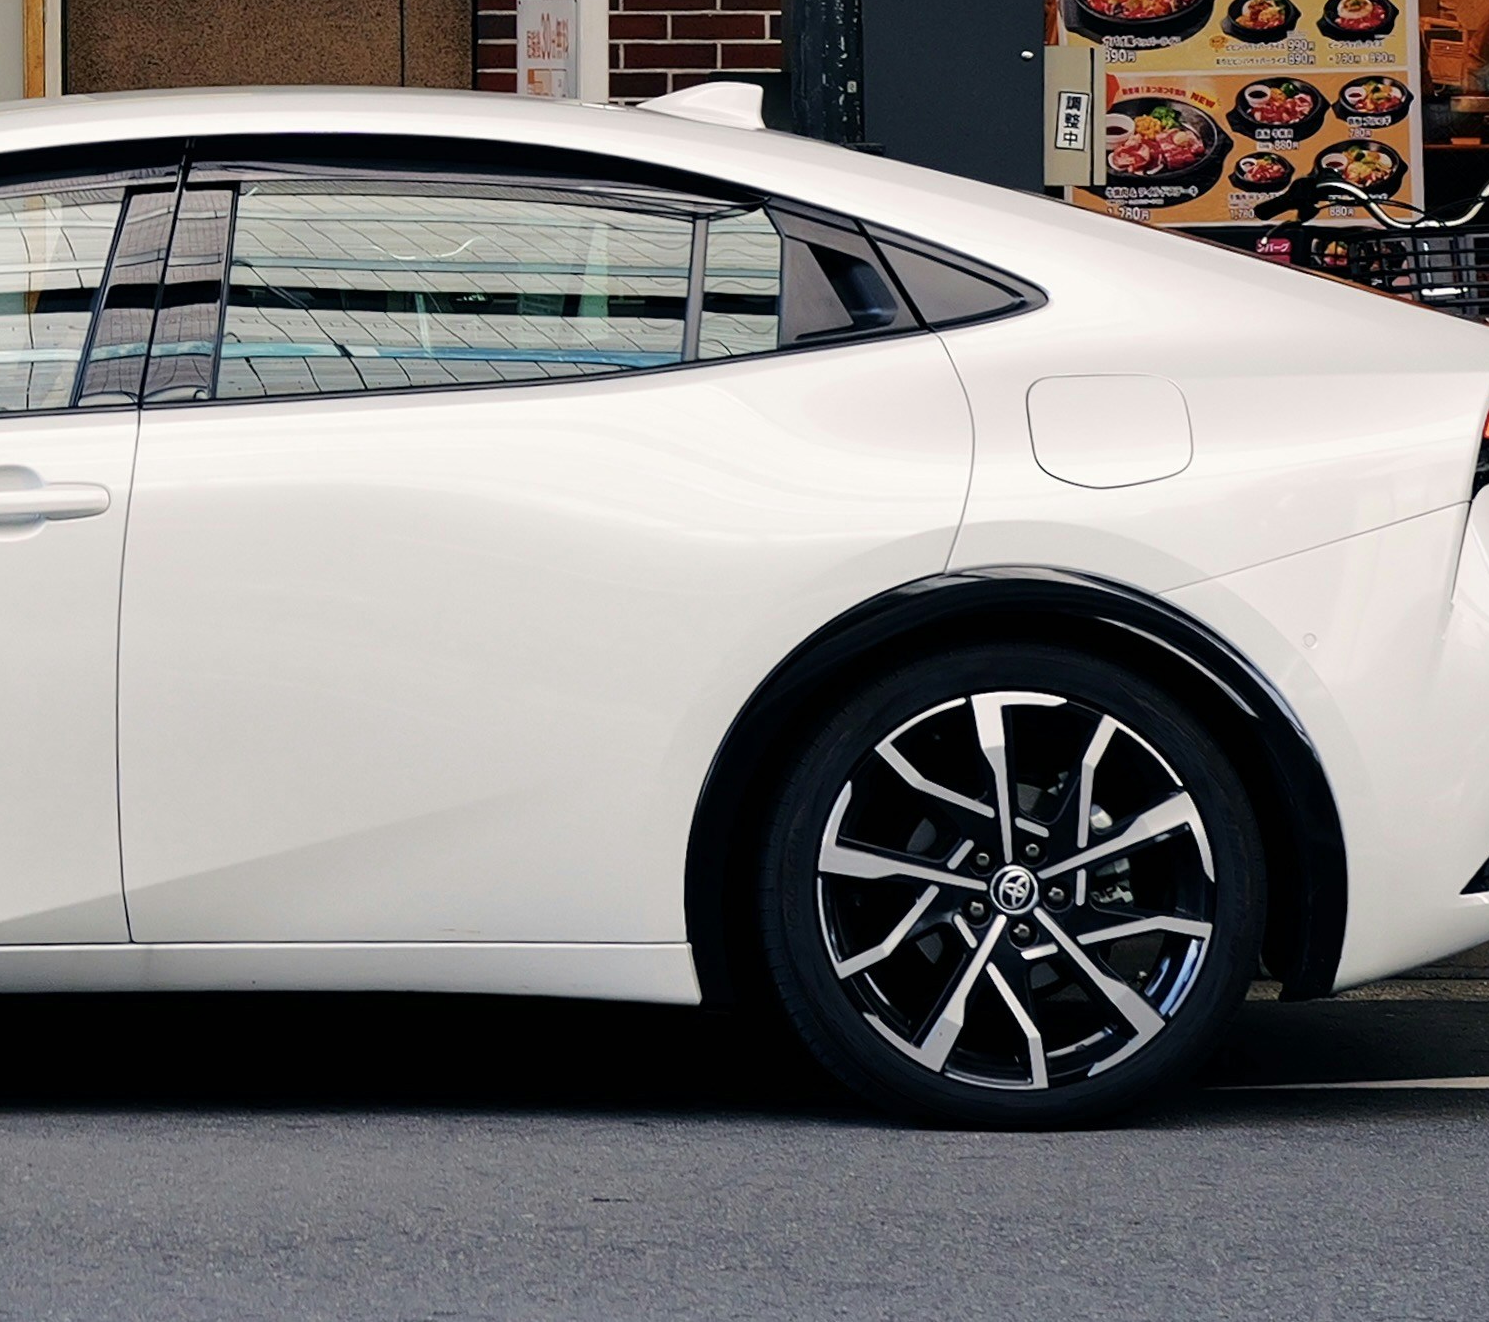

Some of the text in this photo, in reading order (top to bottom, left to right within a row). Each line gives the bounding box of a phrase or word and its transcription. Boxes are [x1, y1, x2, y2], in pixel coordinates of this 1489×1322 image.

[1190, 91, 1216, 109] NEW
[1063, 95, 1083, 147] 調整中
